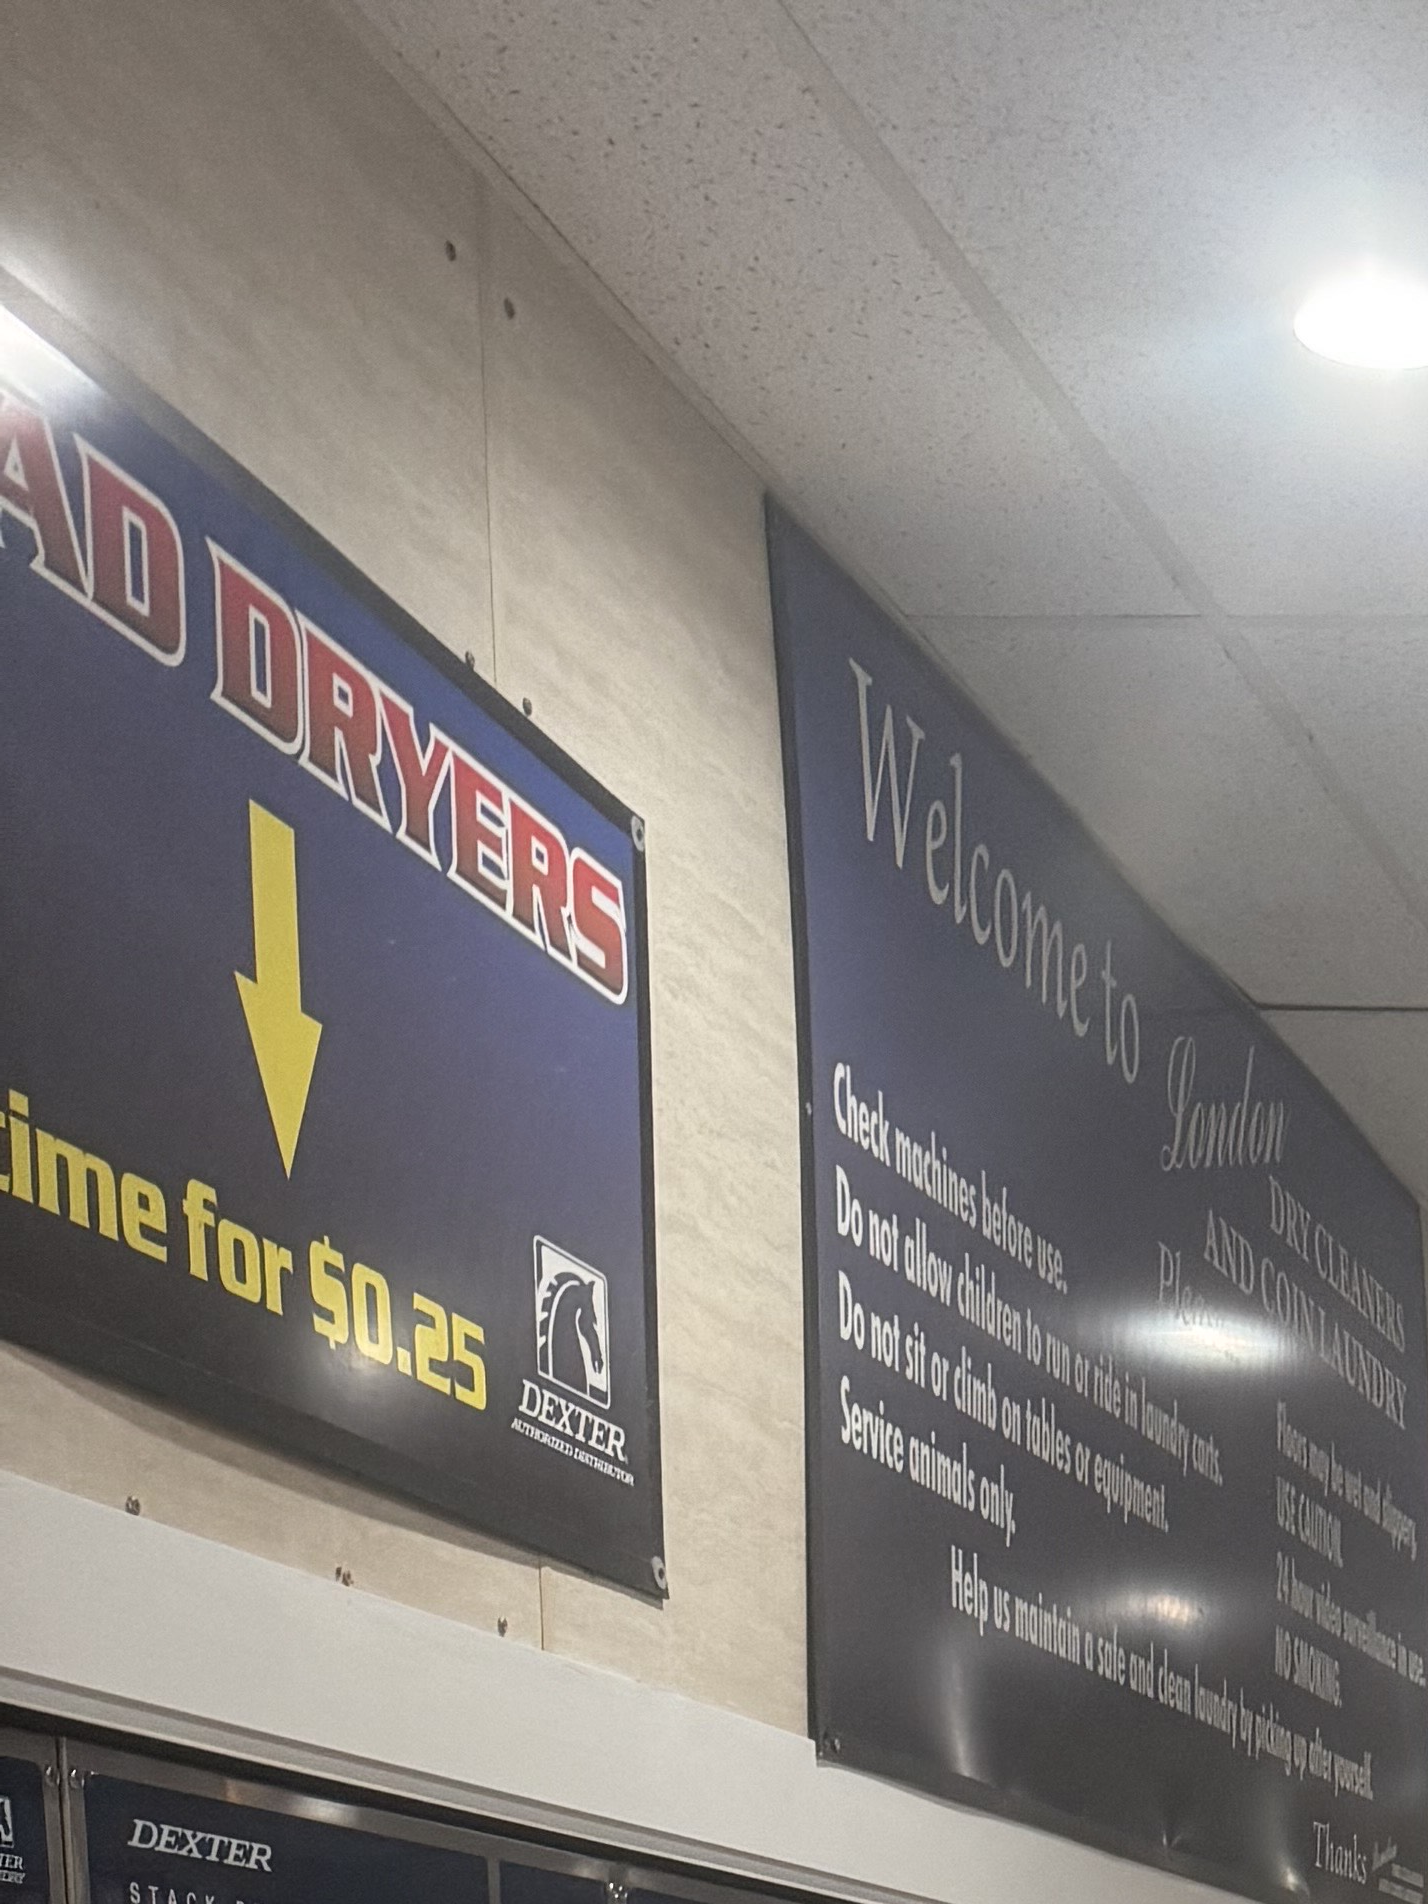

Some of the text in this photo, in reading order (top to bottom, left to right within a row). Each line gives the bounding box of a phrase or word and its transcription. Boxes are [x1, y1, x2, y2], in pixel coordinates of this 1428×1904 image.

[205, 535, 628, 1005] DRYERS
[849, 657, 1140, 1085] Welcome to
[834, 1062, 1068, 1294] Check machines before use.
[1160, 1036, 1290, 1172] London
[0, 1088, 487, 1411] ime for $0.25
[836, 1164, 864, 1247] Do
[869, 1209, 898, 1272] not
[904, 1217, 953, 1307] allow
[957, 1252, 1022, 1355] children
[1026, 1308, 1042, 1366] to
[1046, 1332, 1070, 1386] run
[1074, 1352, 1090, 1398] or
[1094, 1354, 1121, 1419] ride
[1124, 1370, 1138, 1431] in
[1141, 1376, 1190, 1477] laundry
[1203, 1208, 1255, 1295] AND
[1318, 1306, 1407, 1430] LAUNDRY
[1269, 1174, 1405, 1353] DRY CLEANERS
[511, 1417, 574, 1457] AUTHORIZED
[518, 1378, 627, 1463] DEXTER
[838, 1269, 1169, 1533] Do not sit or climb on tables or equipment.
[841, 1375, 1016, 1548] Service animals only.
[951, 1544, 989, 1637] Help
[993, 1586, 1010, 1632] us
[1015, 1592, 1081, 1665] maintain
[1085, 1632, 1094, 1672] a
[1098, 1623, 1126, 1686] safe
[1129, 1641, 1154, 1699] and
[1159, 1648, 1191, 1716] clean
[1195, 1663, 1238, 1749] laundry
[127, 1818, 273, 1872] DEXTER
[1313, 1821, 1367, 1885] Thanks
